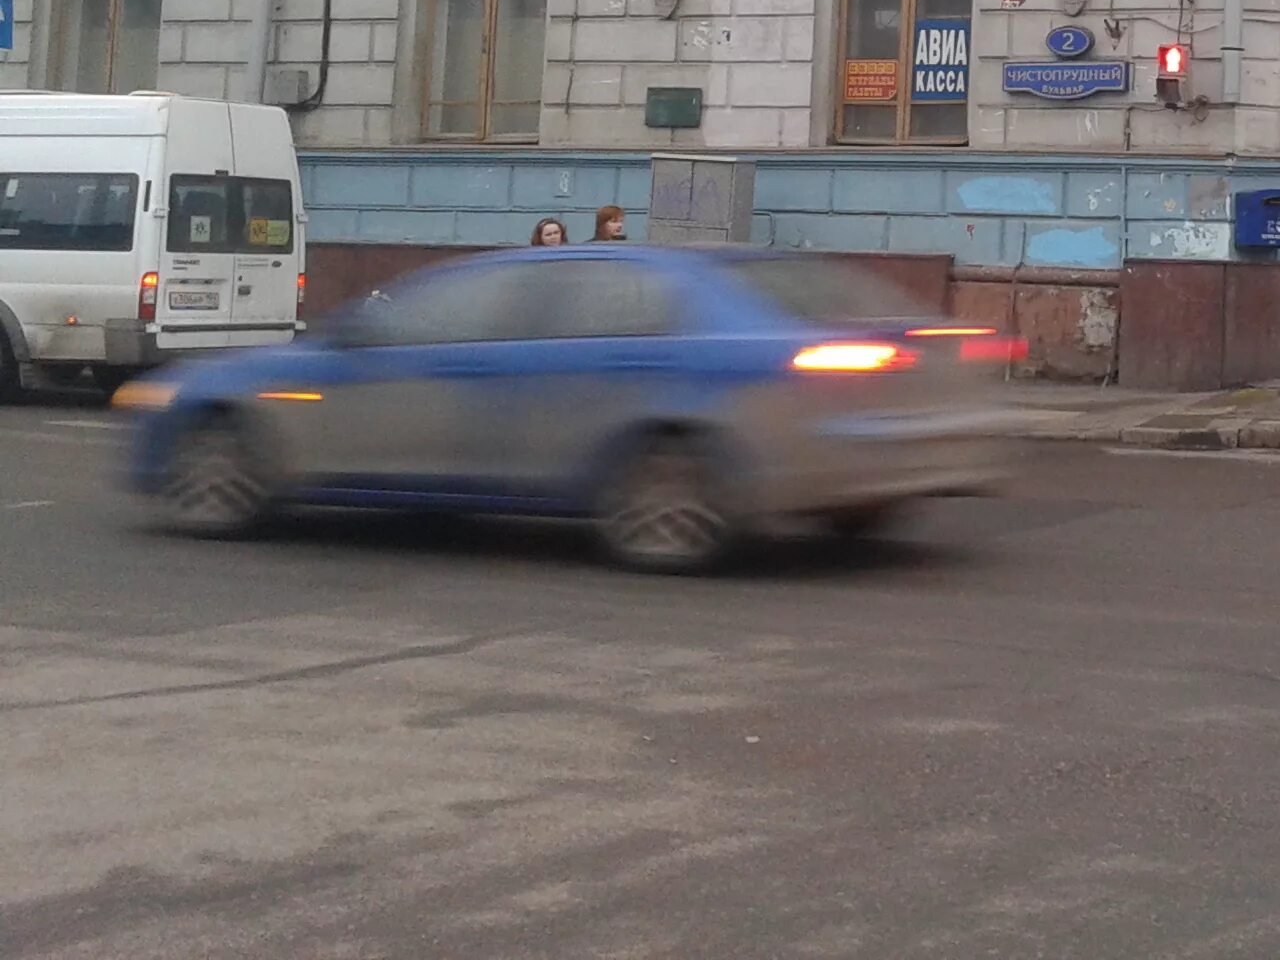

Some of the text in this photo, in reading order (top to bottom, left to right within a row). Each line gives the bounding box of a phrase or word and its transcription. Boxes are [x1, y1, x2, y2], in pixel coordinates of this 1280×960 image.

[915, 29, 968, 65] АВИА
[1062, 32, 1075, 50] 2
[915, 71, 965, 92] КАССА
[1007, 67, 1121, 82] ЧИСТОПРУДНЫЙ
